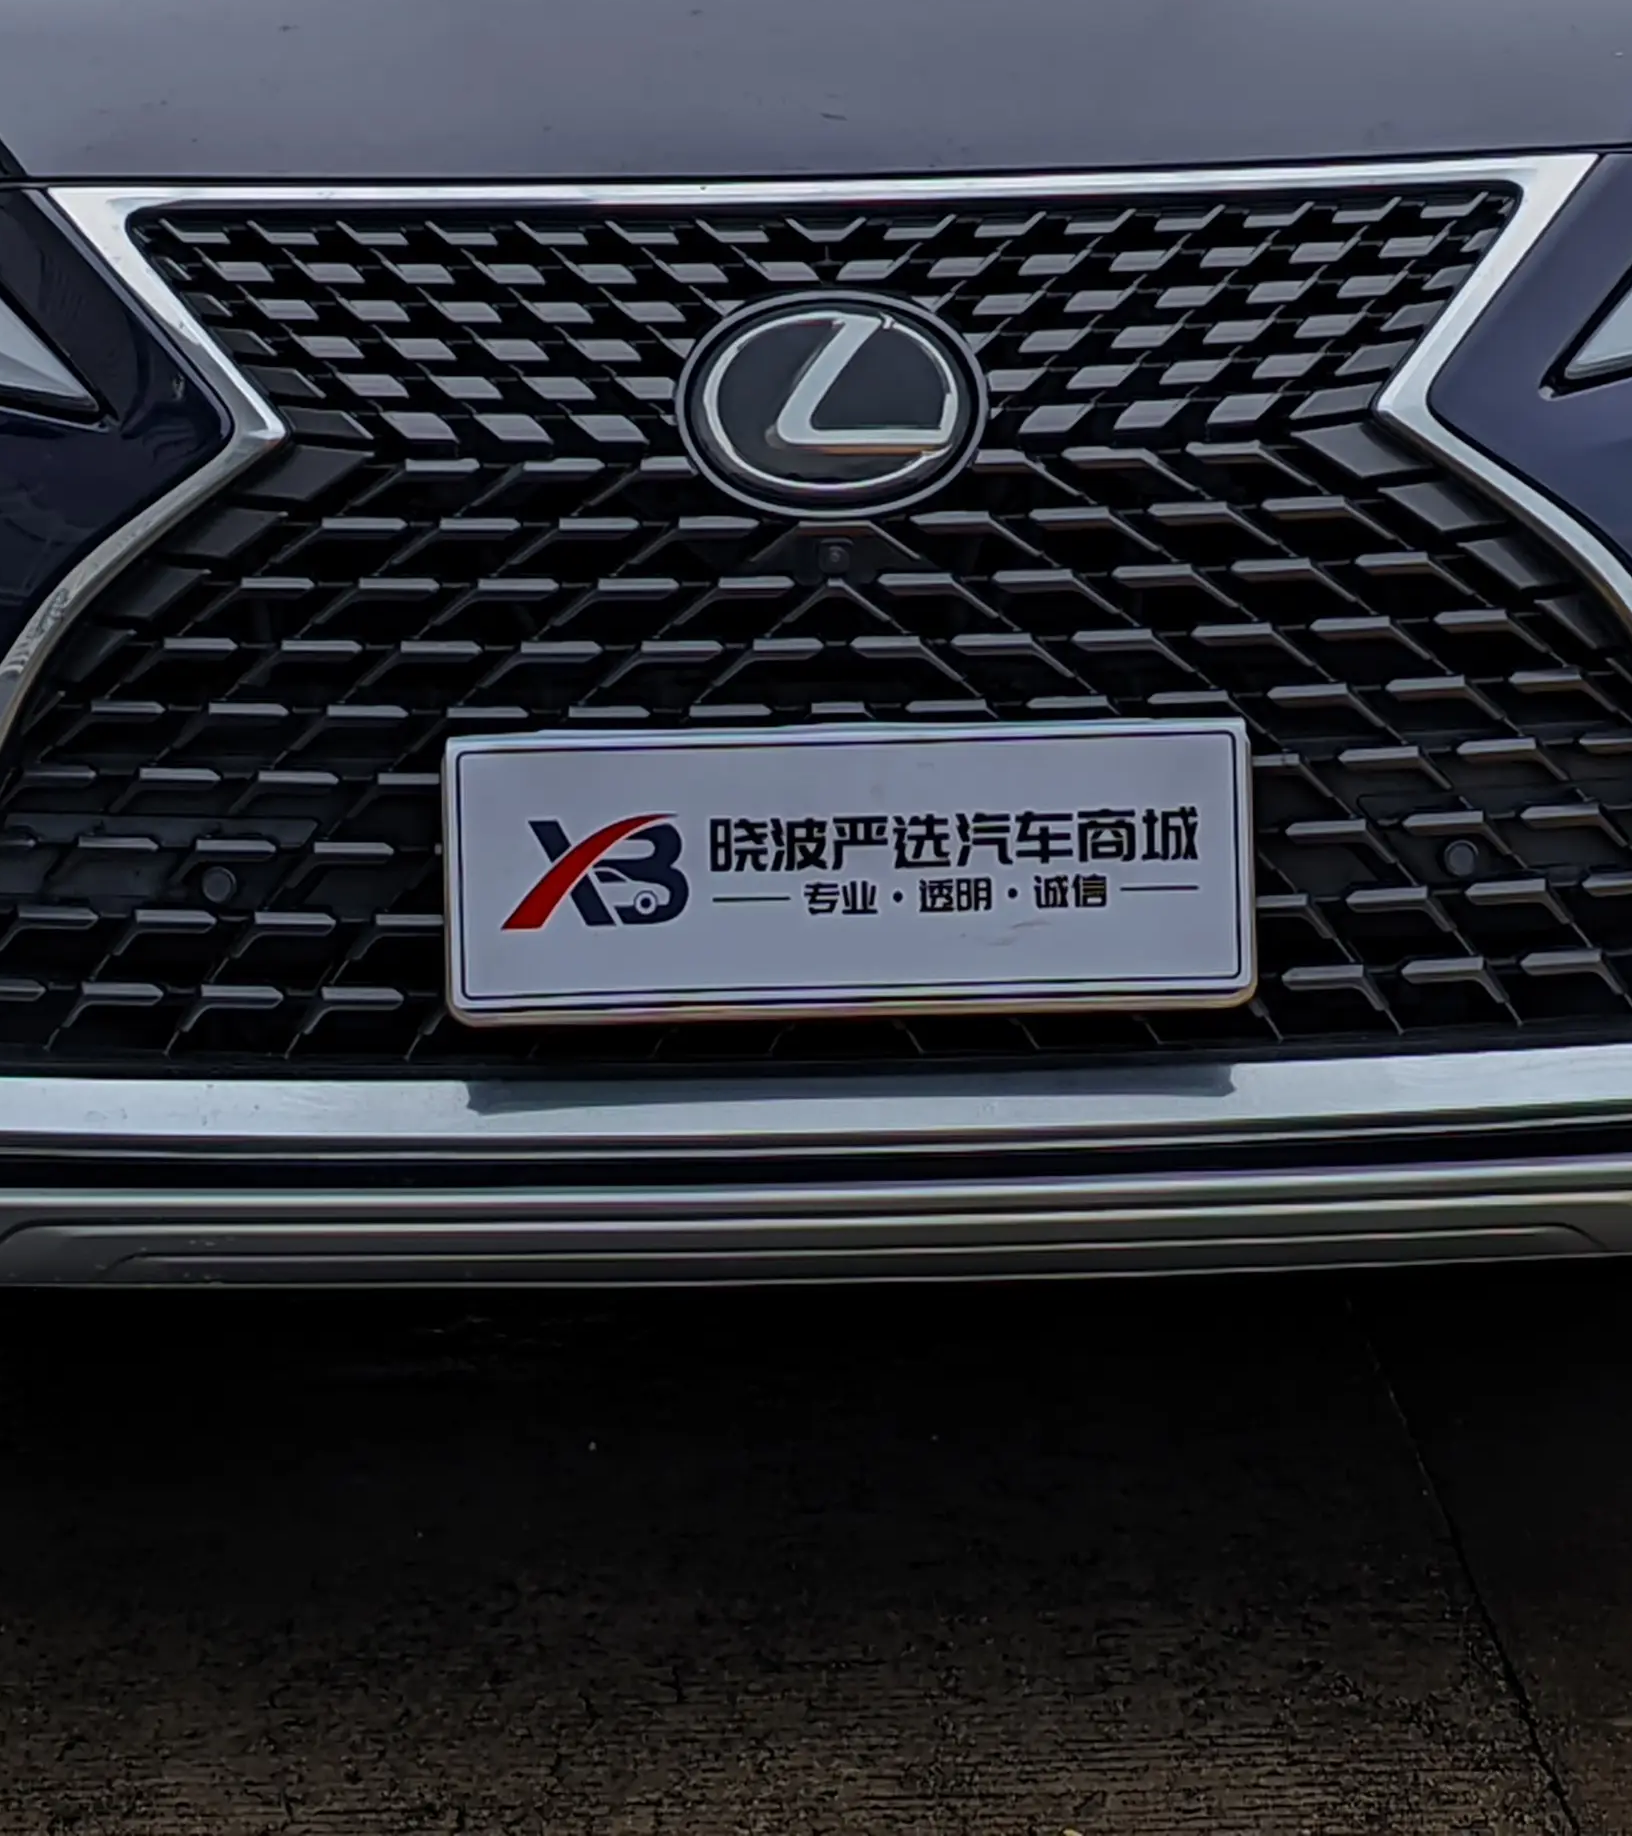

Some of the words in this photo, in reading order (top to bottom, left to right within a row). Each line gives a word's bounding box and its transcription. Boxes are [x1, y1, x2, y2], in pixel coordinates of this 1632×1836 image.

[709, 806, 1199, 873] 晓波严选汽车商城
